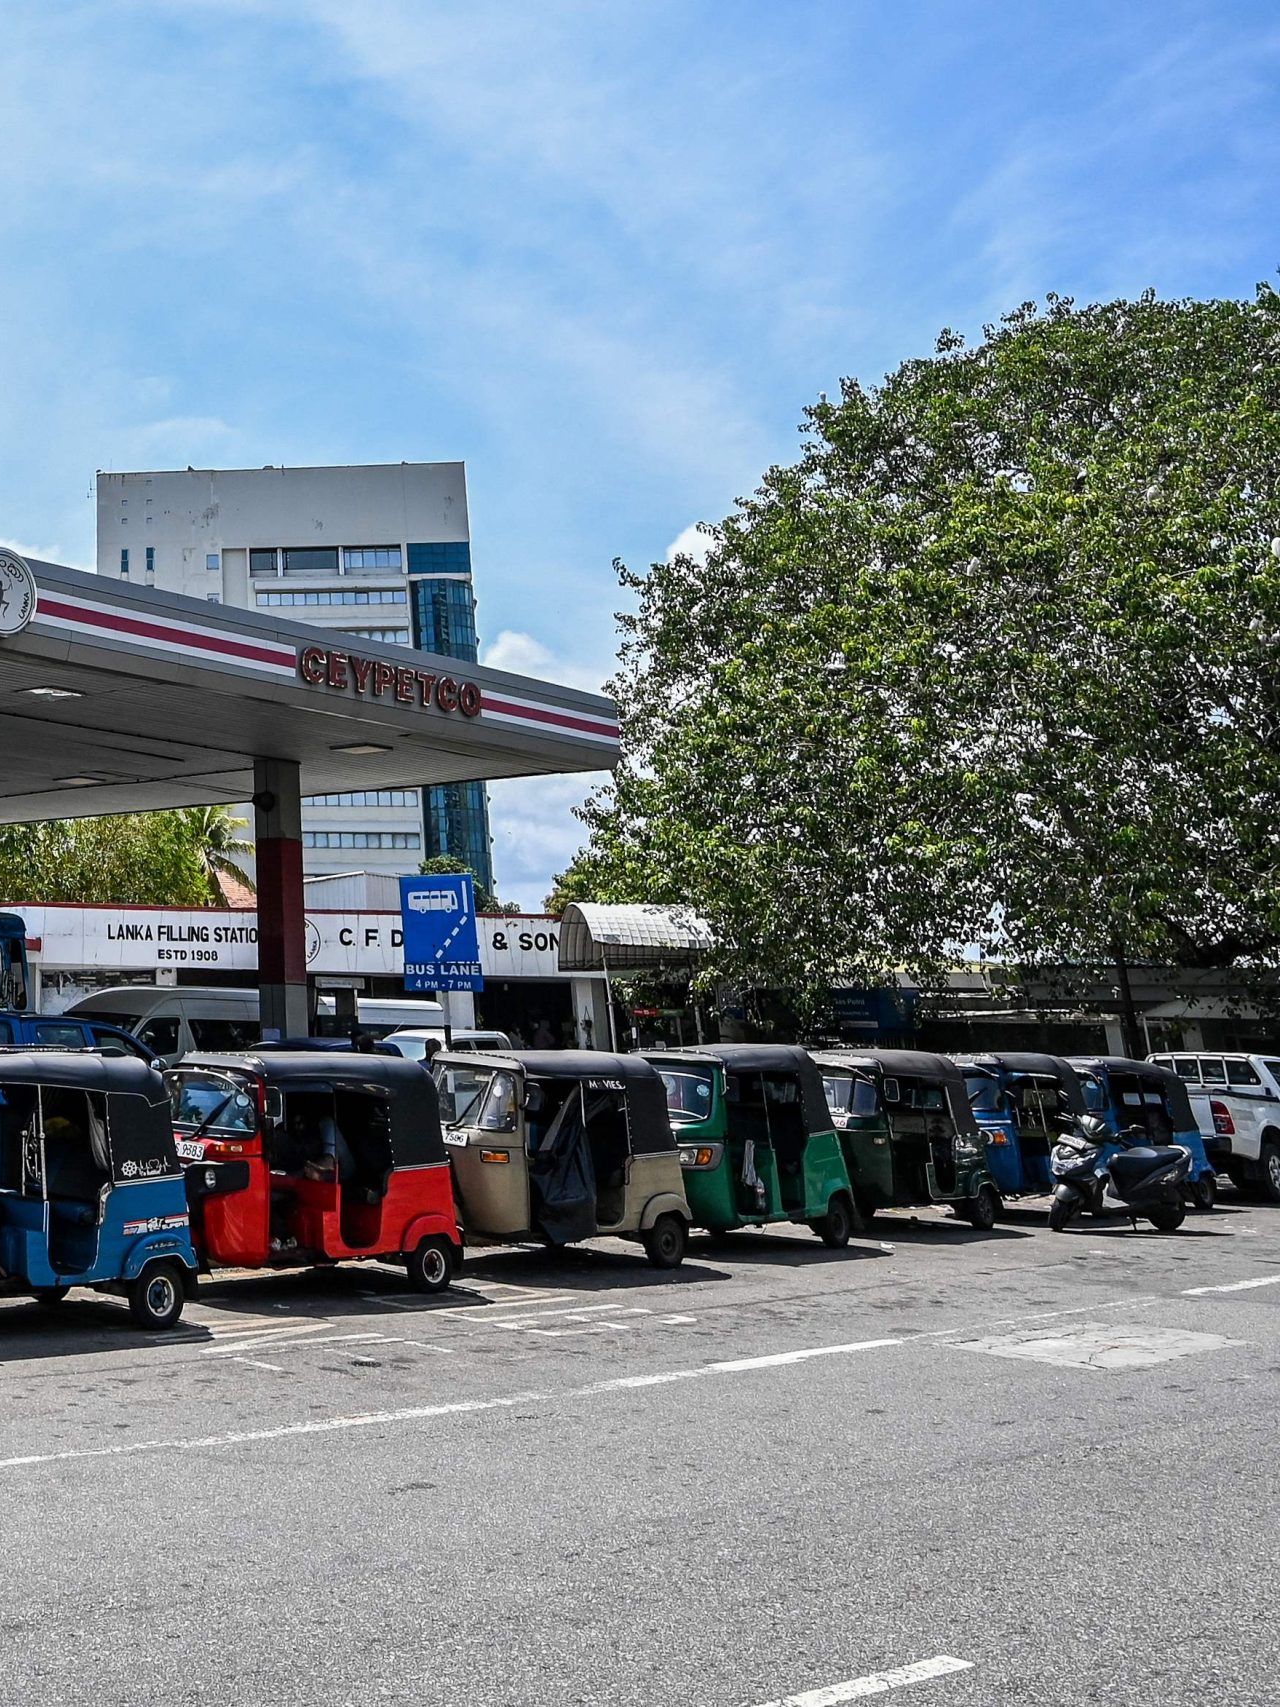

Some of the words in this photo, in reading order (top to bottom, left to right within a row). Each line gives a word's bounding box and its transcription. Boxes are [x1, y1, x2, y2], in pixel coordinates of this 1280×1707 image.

[18, 591, 30, 620] LANKA
[302, 646, 482, 717] CEYPETCO
[107, 924, 153, 941] LANKA
[157, 925, 209, 943] FILLING
[213, 926, 258, 944] STATIO
[338, 927, 356, 947] C.
[364, 928, 380, 947] F.
[492, 932, 509, 951] &
[157, 948, 187, 960] ESTD
[190, 950, 219, 962] 1908
[405, 963, 435, 976] BUS
[440, 963, 480, 976] LANE
[415, 979, 422, 988] 4
[424, 980, 439, 989] PM
[447, 979, 454, 989] 7
[457, 980, 472, 989] PM
[182, 1143, 204, 1158] 9383
